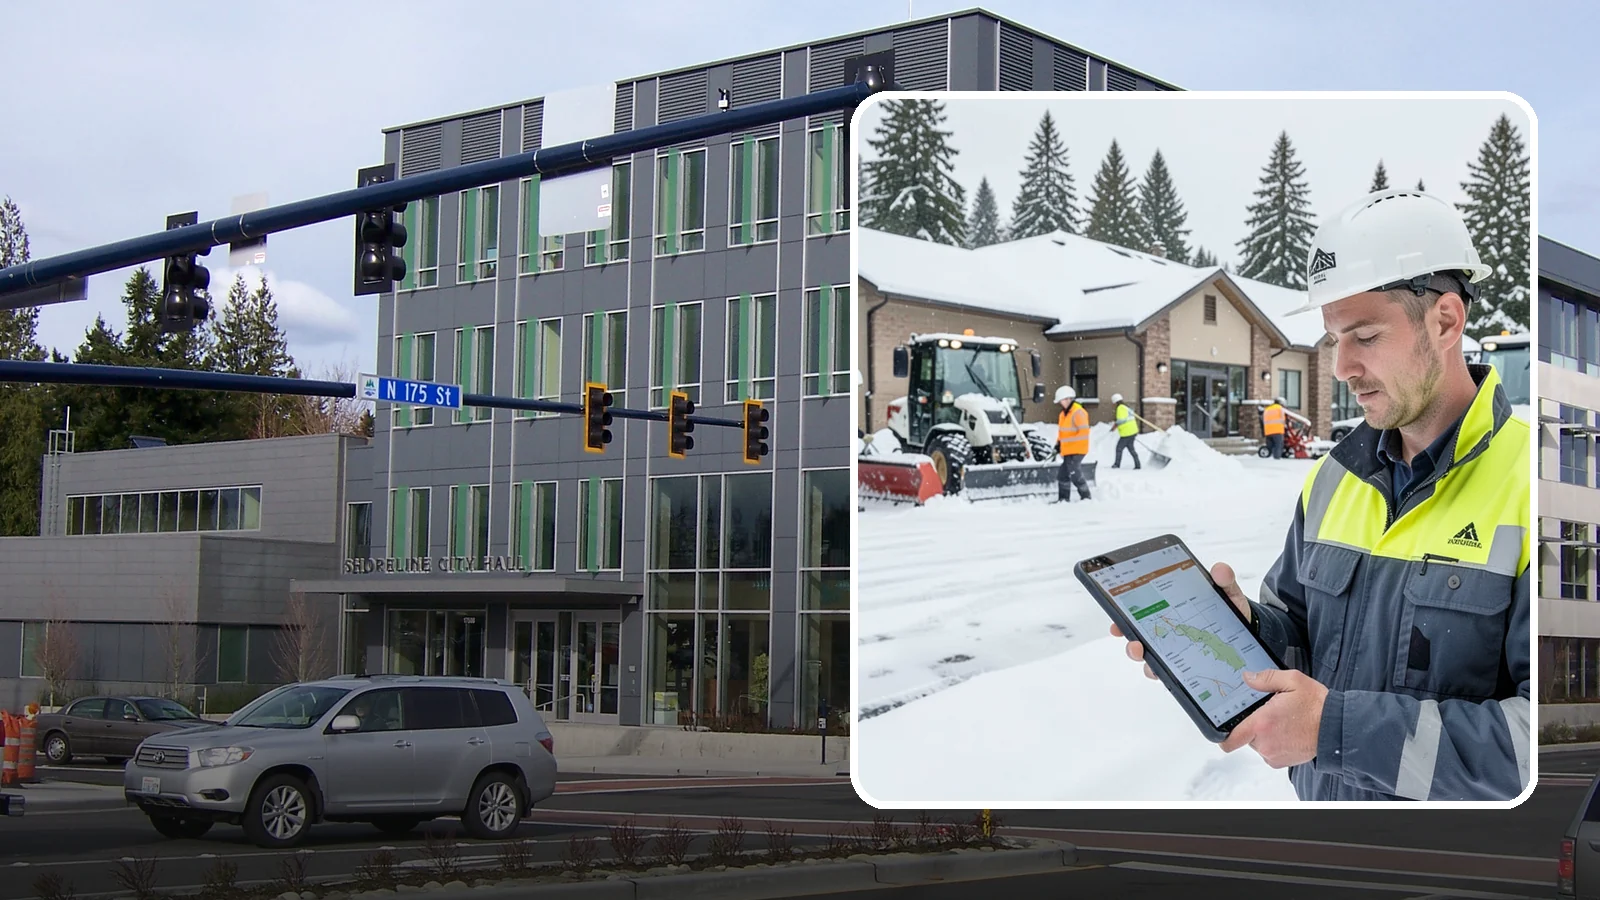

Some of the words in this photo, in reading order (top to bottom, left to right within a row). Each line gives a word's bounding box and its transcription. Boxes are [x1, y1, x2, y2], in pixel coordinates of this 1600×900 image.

[387, 380, 396, 400] N
[405, 383, 427, 403] 175
[436, 386, 451, 406] St
[344, 557, 432, 574] SHORELINE
[438, 556, 475, 572] CITY
[483, 556, 525, 572] HALL
